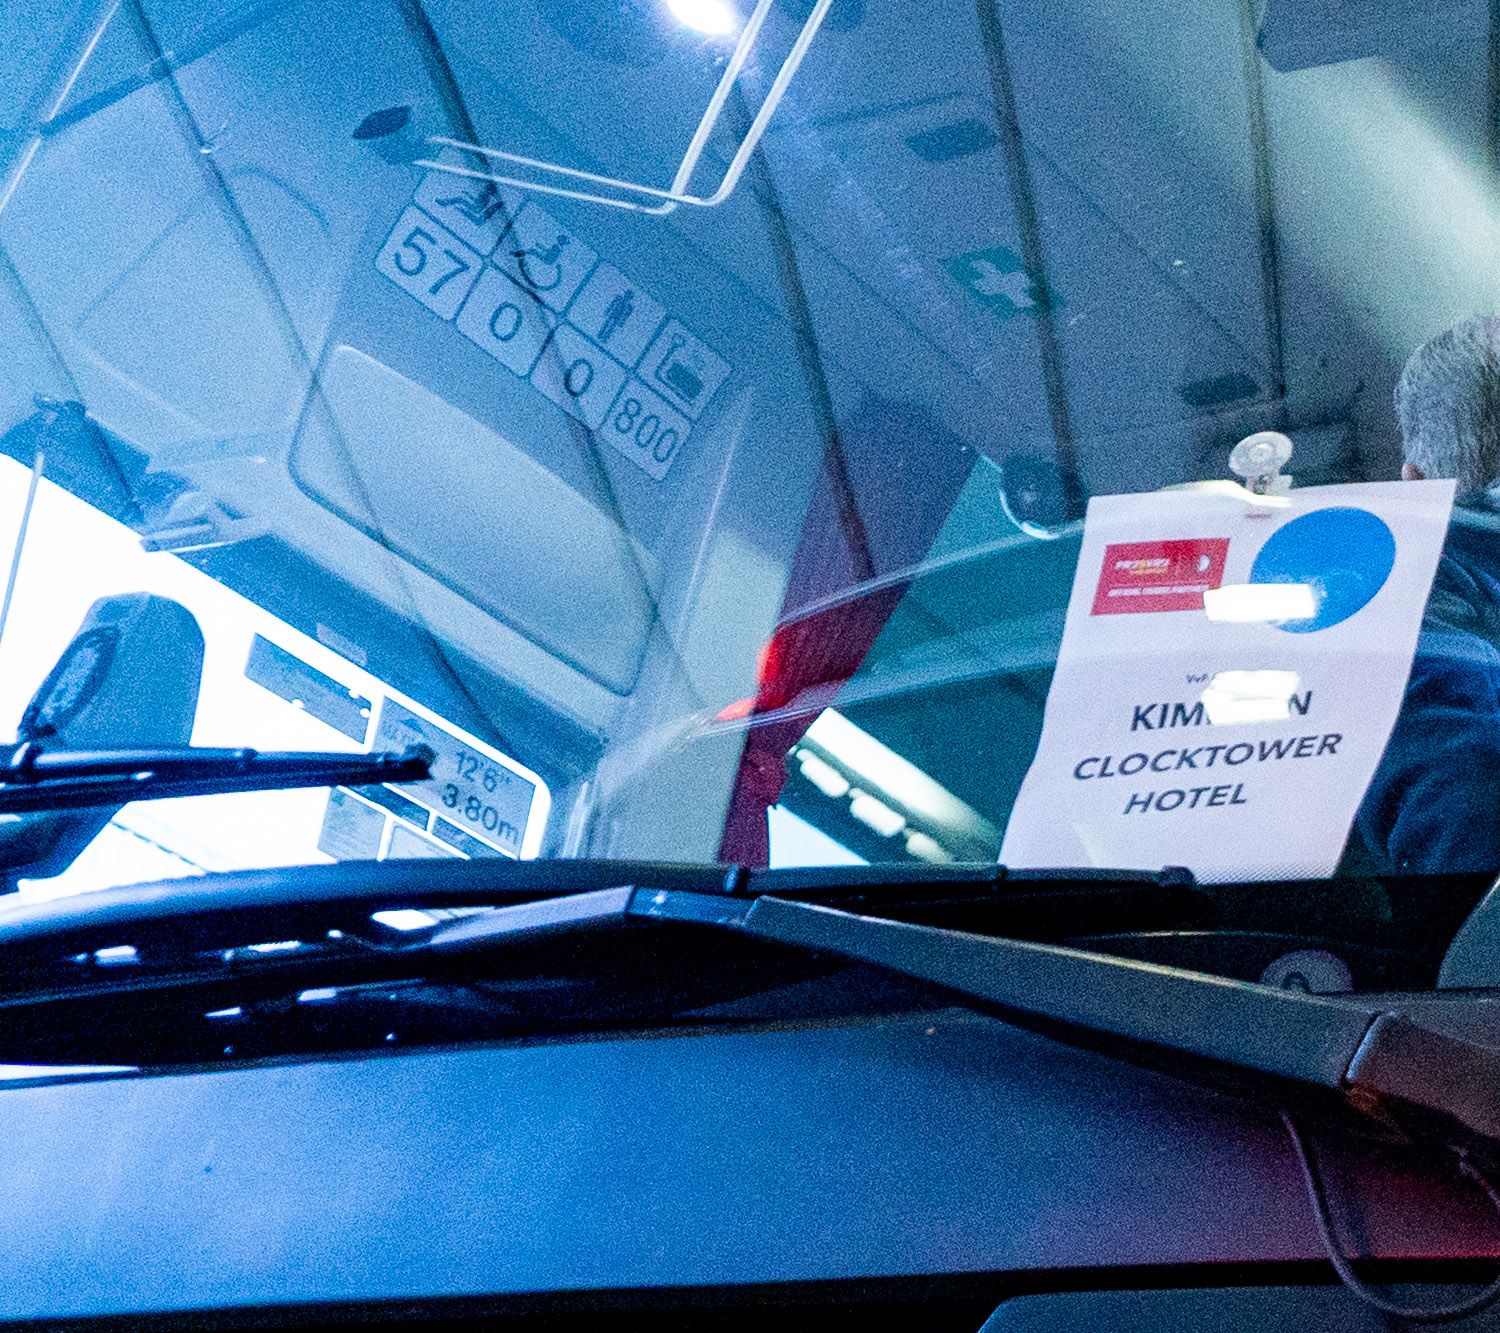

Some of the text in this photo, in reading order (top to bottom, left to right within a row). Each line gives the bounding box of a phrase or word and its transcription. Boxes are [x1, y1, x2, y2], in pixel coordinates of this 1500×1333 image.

[394, 225, 680, 463] 57 0 0 800
[1129, 690, 1313, 732] KIMN
[1072, 733, 1344, 781] CLOCKTOWER
[440, 782, 520, 846] 3.80m
[1122, 783, 1248, 815] HOTEL
